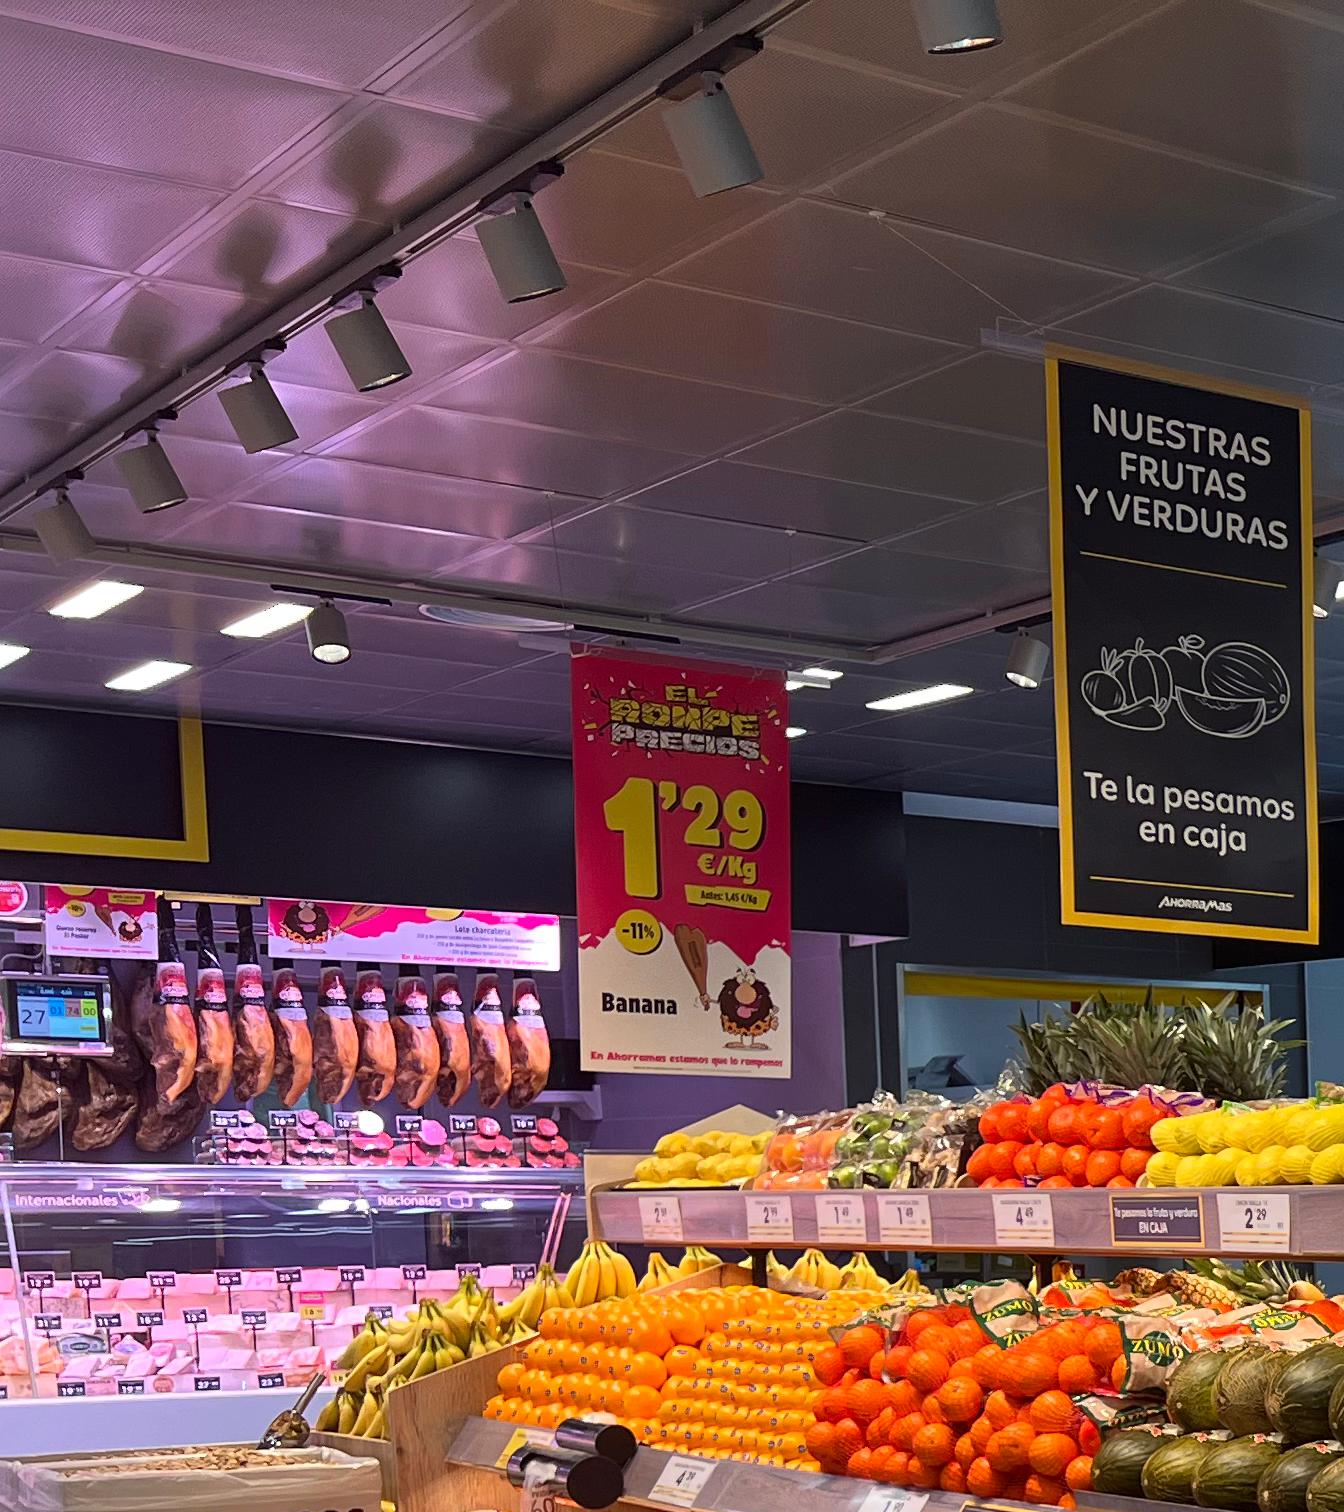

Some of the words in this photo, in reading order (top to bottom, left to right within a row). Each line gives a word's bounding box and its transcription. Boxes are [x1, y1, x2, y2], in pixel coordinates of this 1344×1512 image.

[1093, 404, 1271, 466] NUESTRAS
[1120, 452, 1246, 503] FRUTAS
[1076, 485, 1098, 516] Y
[1107, 491, 1289, 550] VERDURAS
[665, 684, 709, 706] EL
[610, 698, 760, 737] ROMPE
[611, 723, 760, 759] PRECIOS
[1083, 771, 1119, 801] Te
[1126, 776, 1154, 805] la
[1164, 786, 1295, 821] pesamos
[1139, 820, 1175, 845] en
[1183, 825, 1247, 856] caja
[697, 853, 758, 885] €/Kg
[700, 890, 724, 901] Antes:
[622, 923, 654, 939] -11%
[601, 992, 678, 1015] Banana
[22, 1009, 45, 1024] 27
[590, 1051, 604, 1060] En
[607, 1052, 666, 1063] Ahorramas
[669, 1054, 709, 1065] estamos
[711, 1057, 728, 1068] que
[729, 1057, 739, 1066] lo
[740, 1058, 783, 1069] rompemos
[15, 1194, 119, 1207] Internacionales
[377, 1194, 442, 1207] Nacionales
[1139, 1222, 1149, 1233] EN
[1150, 1222, 1168, 1234] CAJA
[982, 1298, 1033, 1323] ZUMO
[1132, 1338, 1184, 1360] ZUMO
